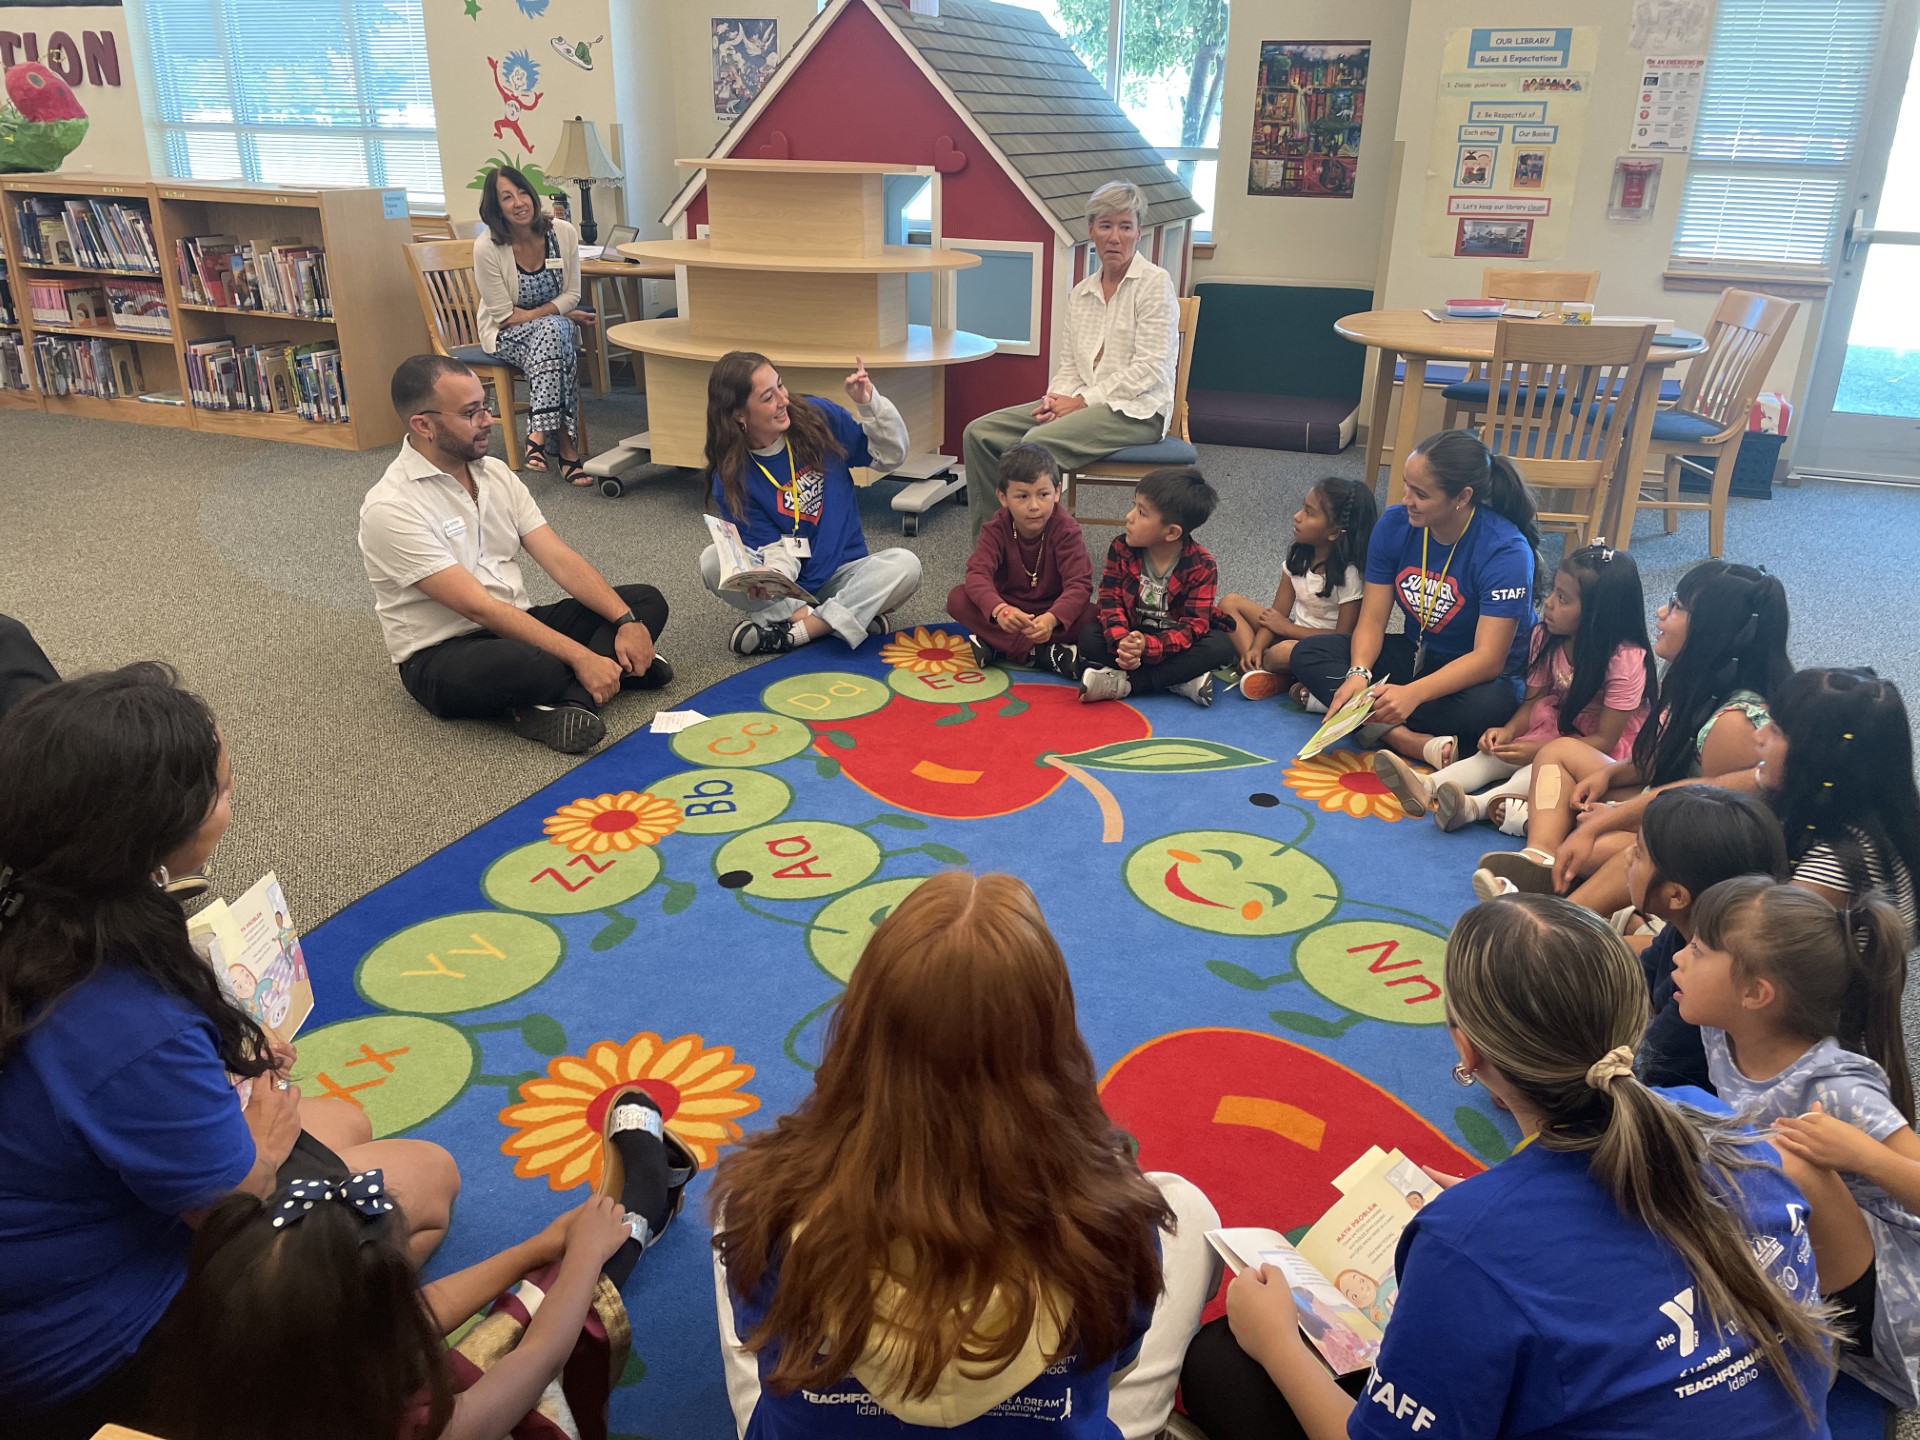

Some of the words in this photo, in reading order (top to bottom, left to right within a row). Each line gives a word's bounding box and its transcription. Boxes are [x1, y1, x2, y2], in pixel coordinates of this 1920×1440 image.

[1495, 37, 1512, 45] OUR
[1515, 37, 1551, 45] LIBRARY
[1480, 55, 1499, 63] Rules
[1502, 55, 1508, 63] &
[1509, 54, 1558, 64] Expectations
[1493, 111, 1527, 119] Respectful
[1463, 128, 1479, 136] Each
[1479, 128, 1497, 136] other
[1479, 203, 1493, 211] keep
[1505, 203, 1527, 211] library
[1491, 587, 1526, 601] STAFF
[917, 671, 986, 690] Ee
[708, 722, 778, 756] Cc
[683, 779, 737, 817] Bb
[765, 835, 833, 879] Aa
[529, 853, 617, 892] Zz
[400, 933, 507, 979] Yy
[1346, 940, 1442, 1005] Nn
[312, 1044, 411, 1109] Xx
[1336, 1225, 1352, 1243] MATH
[1350, 1202, 1378, 1228] PROBLEM
[1656, 1333, 1676, 1351] the
[1706, 1346, 1732, 1367] Pesky
[1042, 1365, 1069, 1375] HOOL
[1728, 1368, 1758, 1392] Idaho
[801, 1389, 876, 1405] TEACHFO
[1015, 1396, 1021, 1404] A
[1366, 1366, 1436, 1432] TAFF
[992, 1403, 1037, 1413] UNDATION
